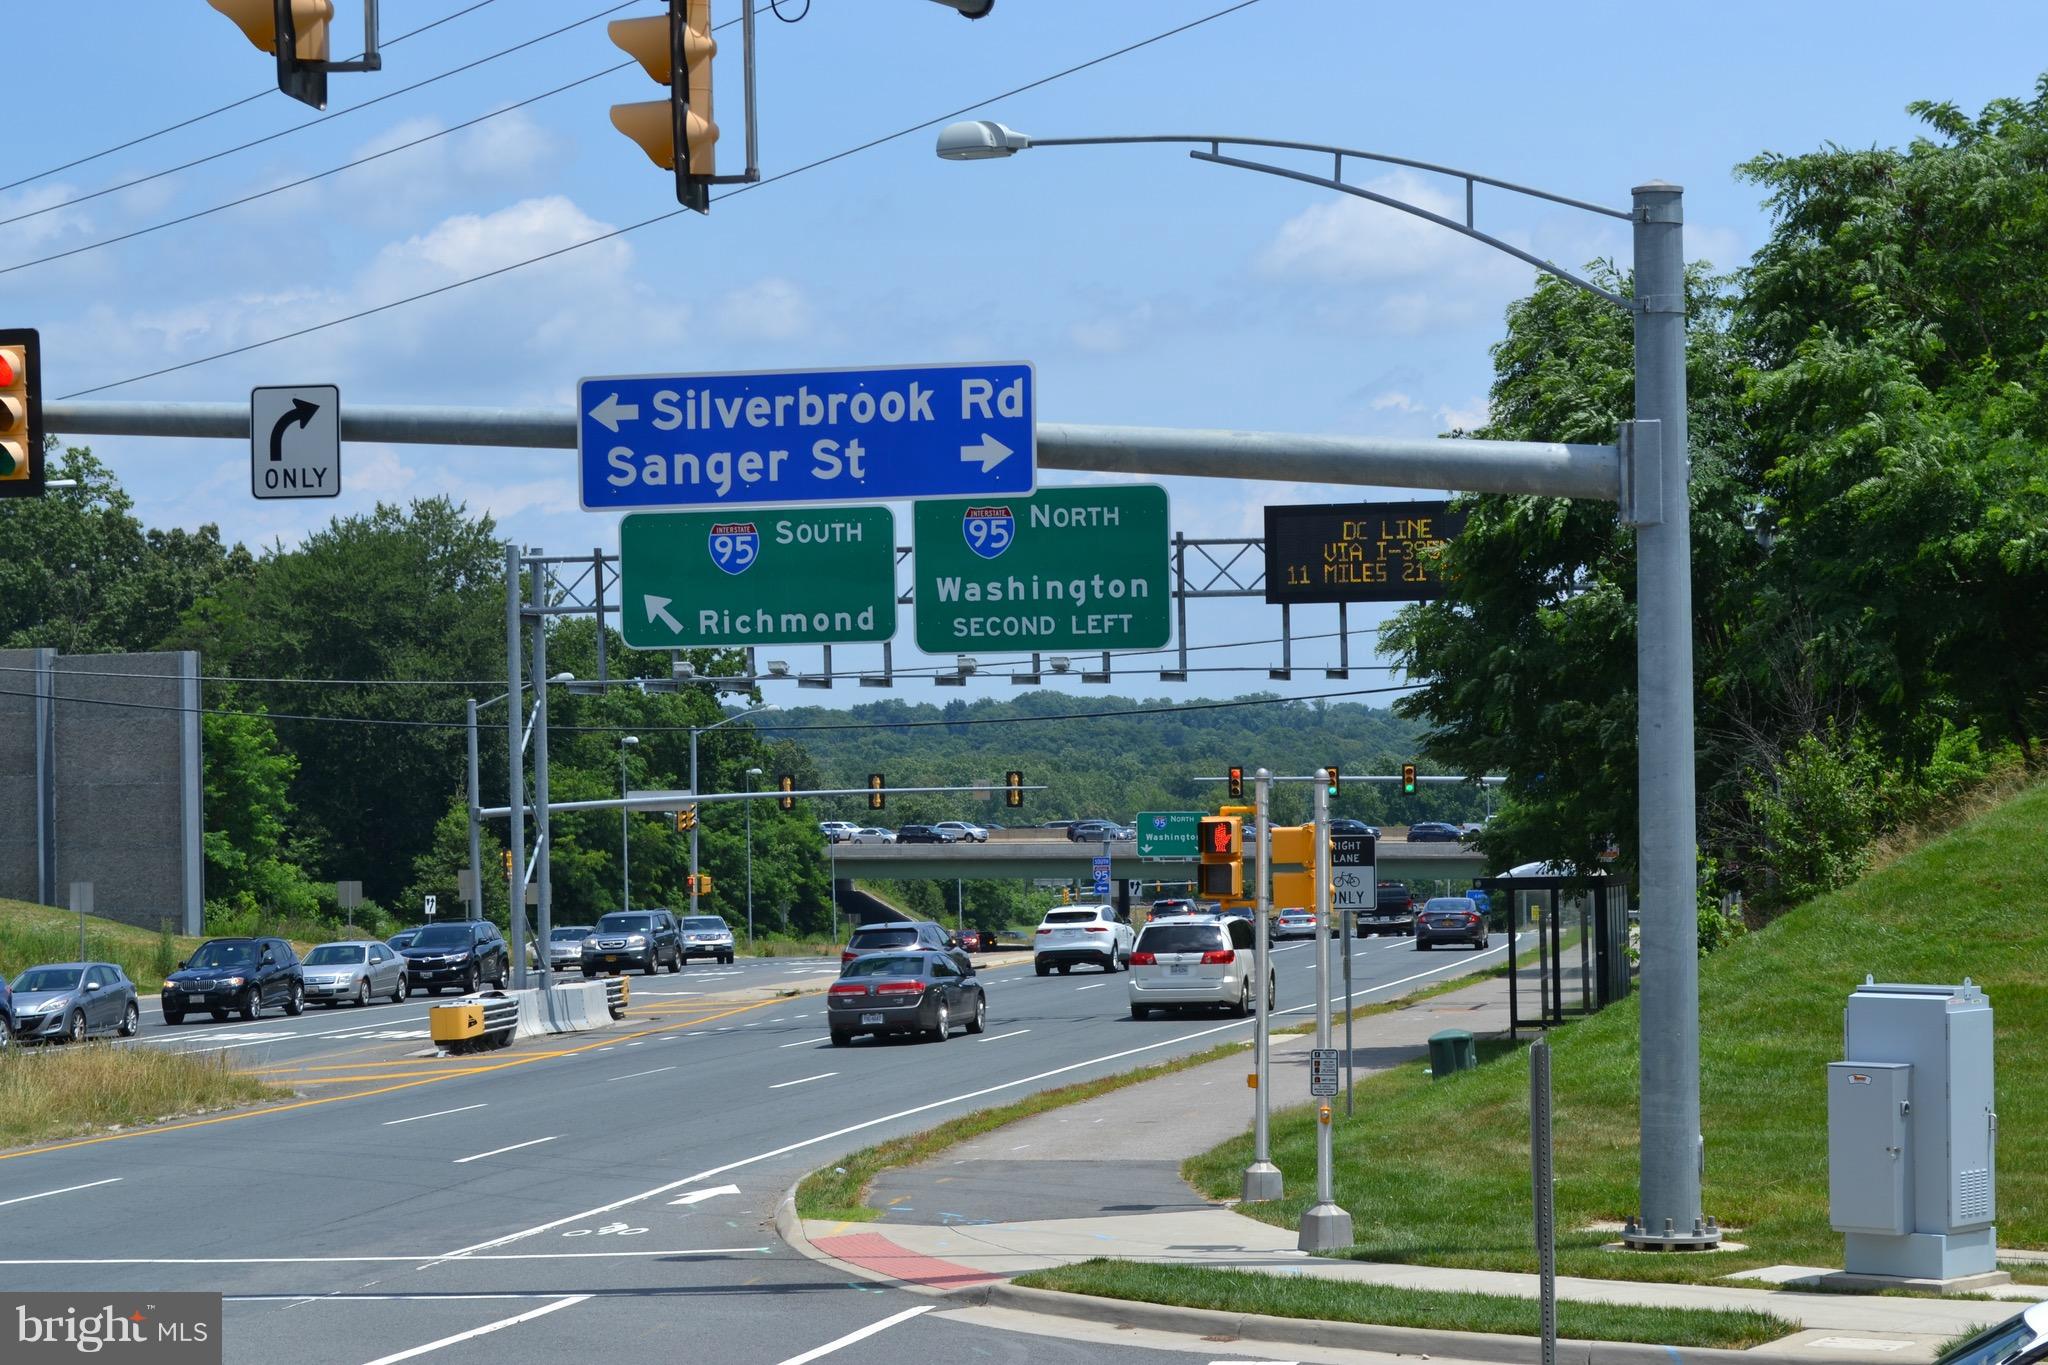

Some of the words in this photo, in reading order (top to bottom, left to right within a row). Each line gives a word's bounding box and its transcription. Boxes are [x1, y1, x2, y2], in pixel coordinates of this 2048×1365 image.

[652, 381, 935, 431] Silverbrook
[961, 377, 1023, 419] Rd
[265, 467, 327, 489] ONLY
[607, 446, 789, 497] Sanger
[811, 438, 865, 480] St
[966, 508, 1006, 517] INTERSTATE
[969, 519, 1009, 548] 95
[1343, 521, 1368, 540] DC
[1382, 519, 1433, 538] LINE
[714, 536, 754, 564] 95
[1324, 542, 1363, 562] VIA
[1287, 564, 1311, 584] 11
[1324, 563, 1387, 583] MILES
[1402, 562, 1427, 581] 21
[936, 574, 1148, 607] Washington
[700, 605, 874, 634] Richmond
[953, 616, 1056, 637] SECOND
[1071, 614, 1133, 634] LEFT
[1154, 818, 1166, 827] 95
[1146, 833, 1198, 842] Washingto
[1334, 854, 1360, 862] LANE
[1094, 870, 1109, 880] 95
